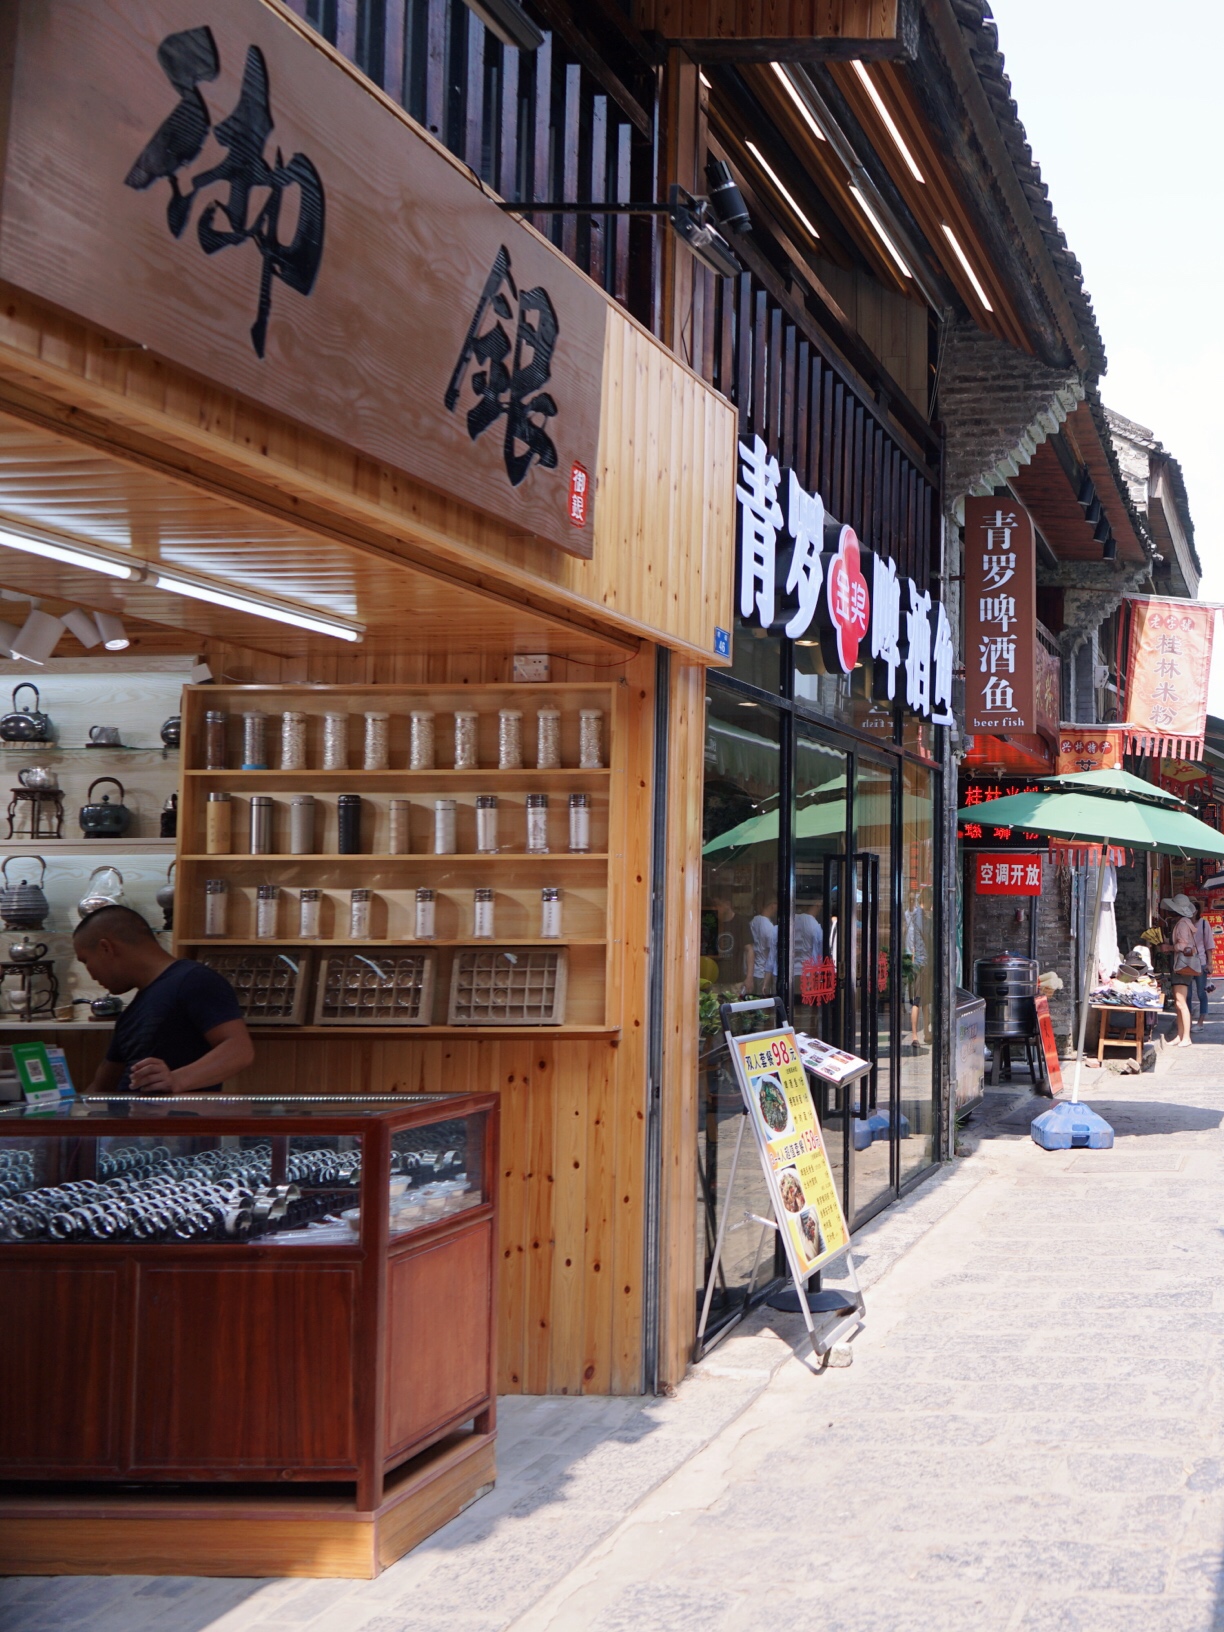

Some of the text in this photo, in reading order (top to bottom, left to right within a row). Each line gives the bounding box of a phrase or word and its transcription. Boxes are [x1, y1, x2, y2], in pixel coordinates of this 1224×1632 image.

[979, 509, 1019, 714] 青罗啤酒鱼
[1149, 633, 1182, 726] 桂林米粉
[973, 717, 1025, 727] beer fish
[980, 862, 1040, 886] 空调开放
